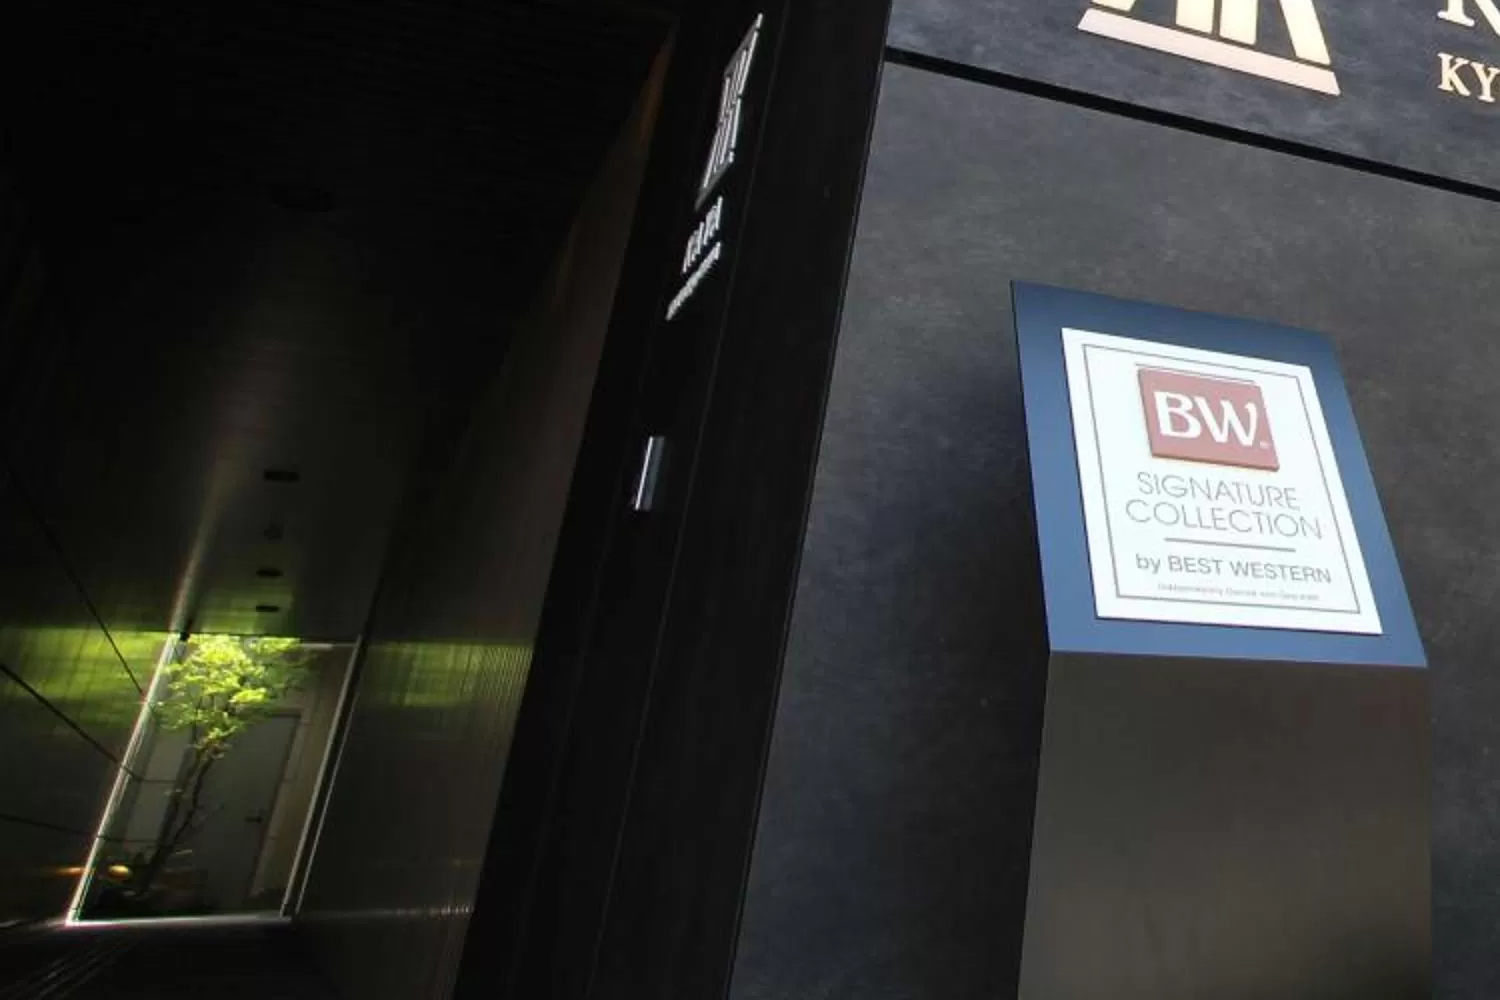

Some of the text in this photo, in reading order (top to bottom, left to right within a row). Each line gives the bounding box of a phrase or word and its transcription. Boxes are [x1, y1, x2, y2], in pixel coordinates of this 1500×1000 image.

[1137, 471, 1302, 512] SIGNATURE
[1126, 499, 1323, 540] COLLECTION
[1135, 553, 1332, 584] by BEST WESTERN
